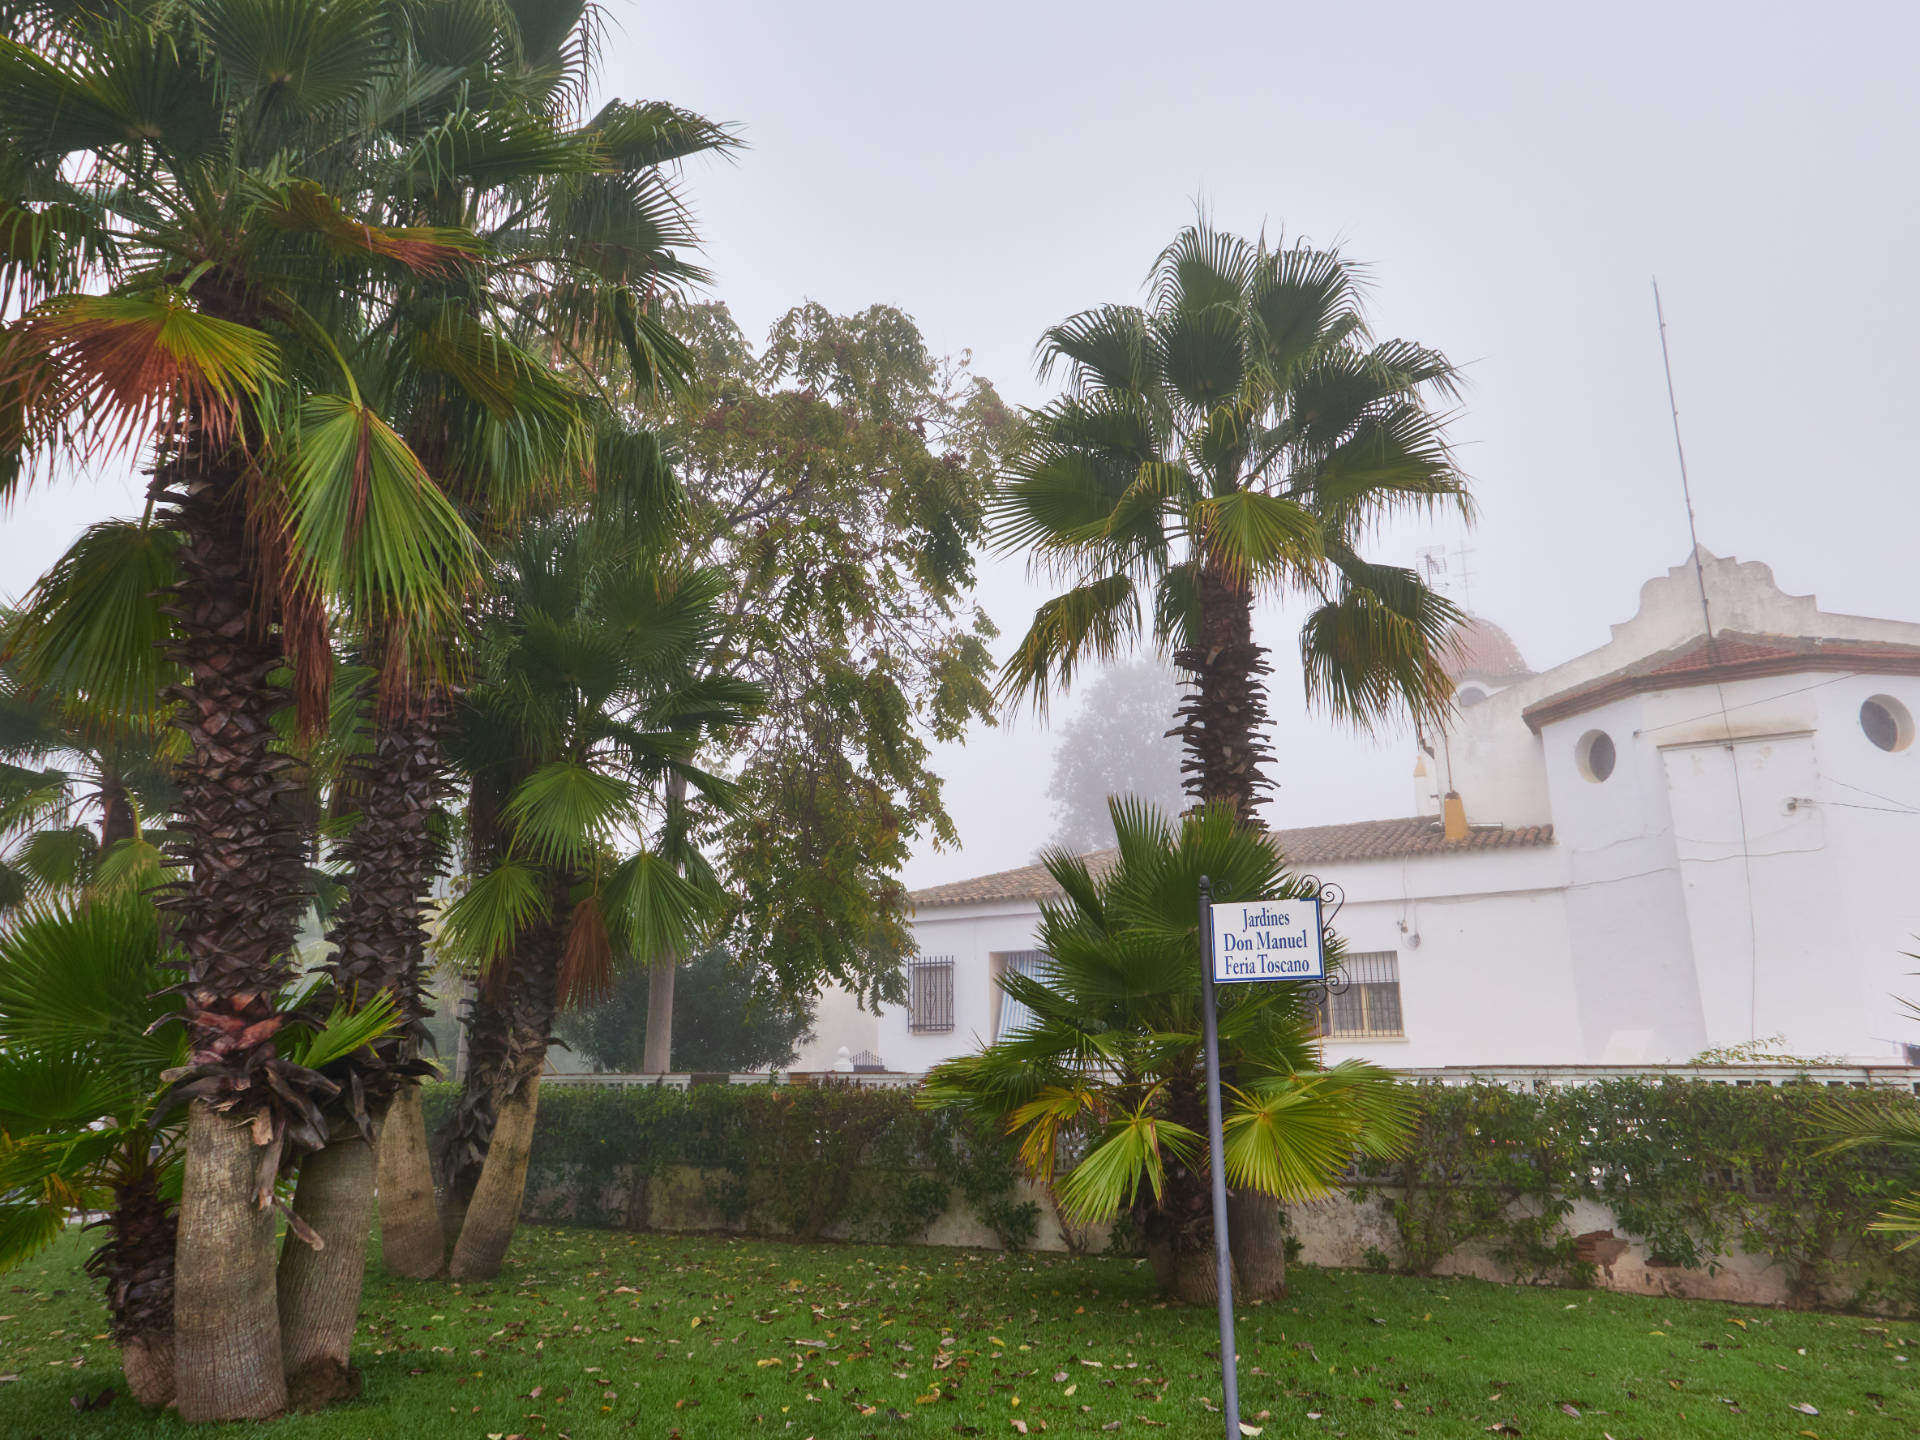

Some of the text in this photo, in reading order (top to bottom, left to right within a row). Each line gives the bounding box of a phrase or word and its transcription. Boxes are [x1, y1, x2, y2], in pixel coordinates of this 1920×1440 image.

[1242, 907, 1290, 932] Jardines
[1223, 929, 1308, 951] Don Manuel
[1224, 954, 1310, 975] Feria Toscano
